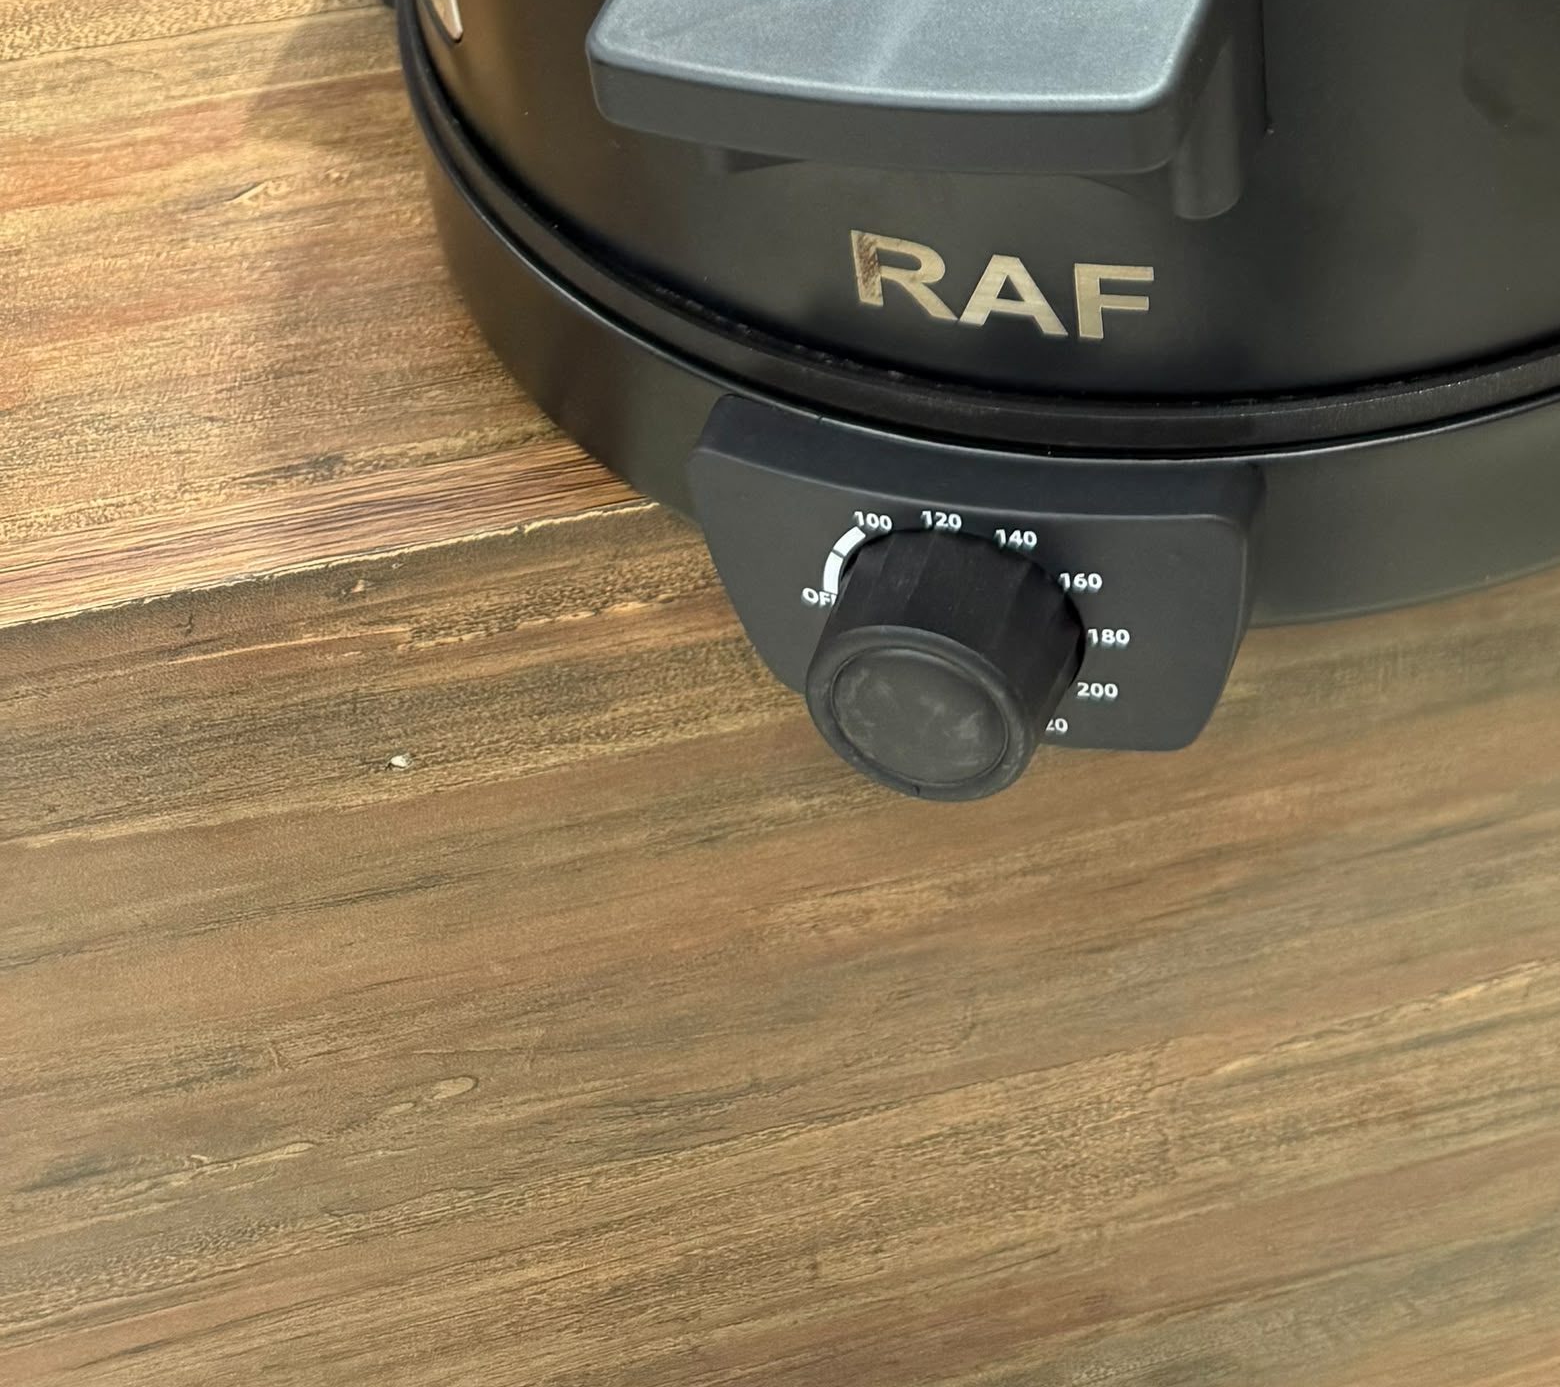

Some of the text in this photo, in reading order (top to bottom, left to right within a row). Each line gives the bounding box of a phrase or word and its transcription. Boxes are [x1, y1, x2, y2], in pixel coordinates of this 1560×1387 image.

[850, 228, 1155, 340] RAF
[853, 510, 893, 531] 100
[921, 510, 963, 530] 120
[995, 527, 1038, 549] 140
[1058, 571, 1103, 594] 160
[1086, 628, 1131, 648] 180
[1076, 681, 1119, 702] 200
